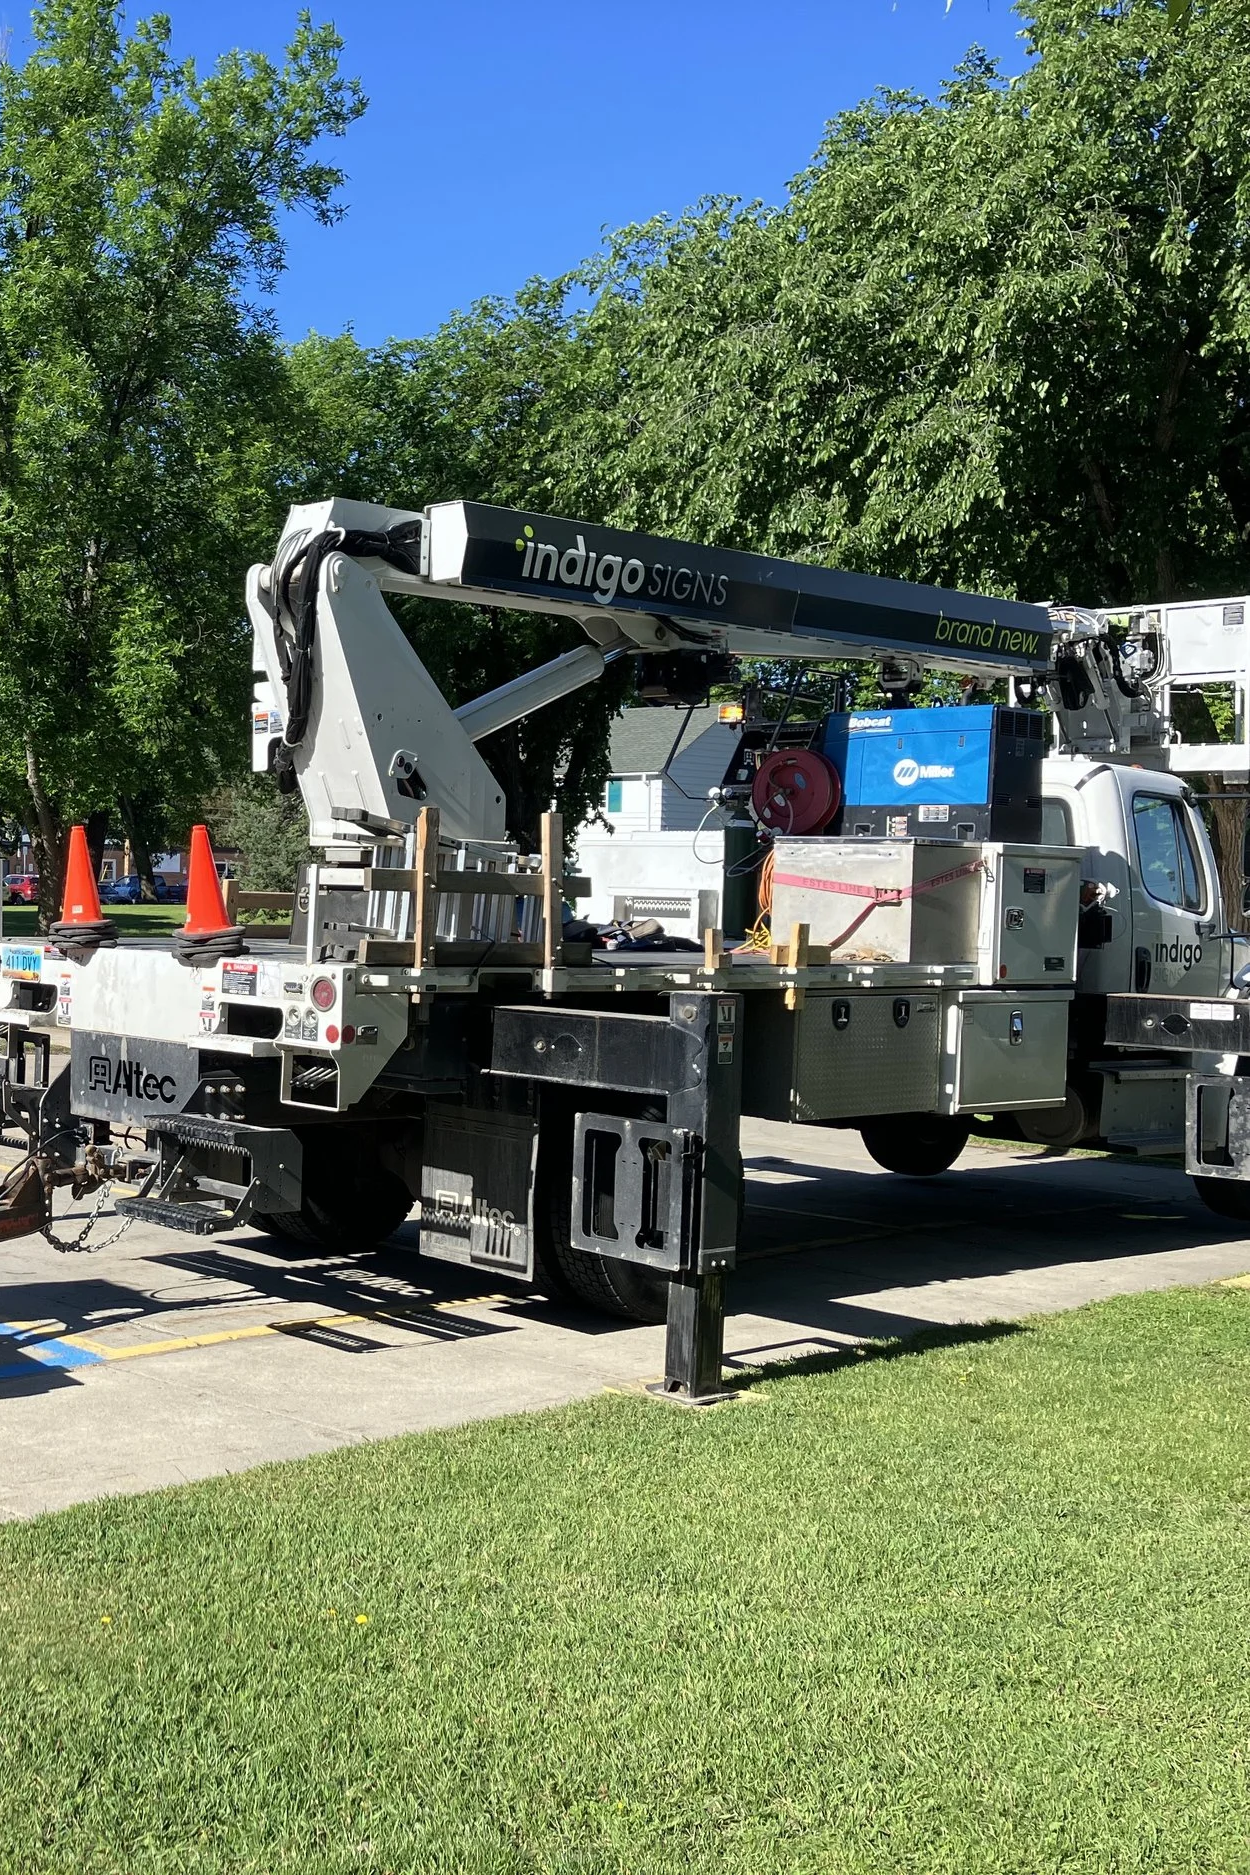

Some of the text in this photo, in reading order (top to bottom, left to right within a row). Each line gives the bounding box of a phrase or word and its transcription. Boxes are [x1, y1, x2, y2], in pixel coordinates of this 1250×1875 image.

[519, 526, 729, 606] indigo SIGNS
[935, 610, 1040, 655] brand new.
[848, 716, 892, 728] Bobcat
[6, 955, 37, 971] 411 DVY
[1155, 935, 1203, 972] indigo
[112, 1060, 177, 1104] Altec
[459, 1196, 516, 1231] Altec
